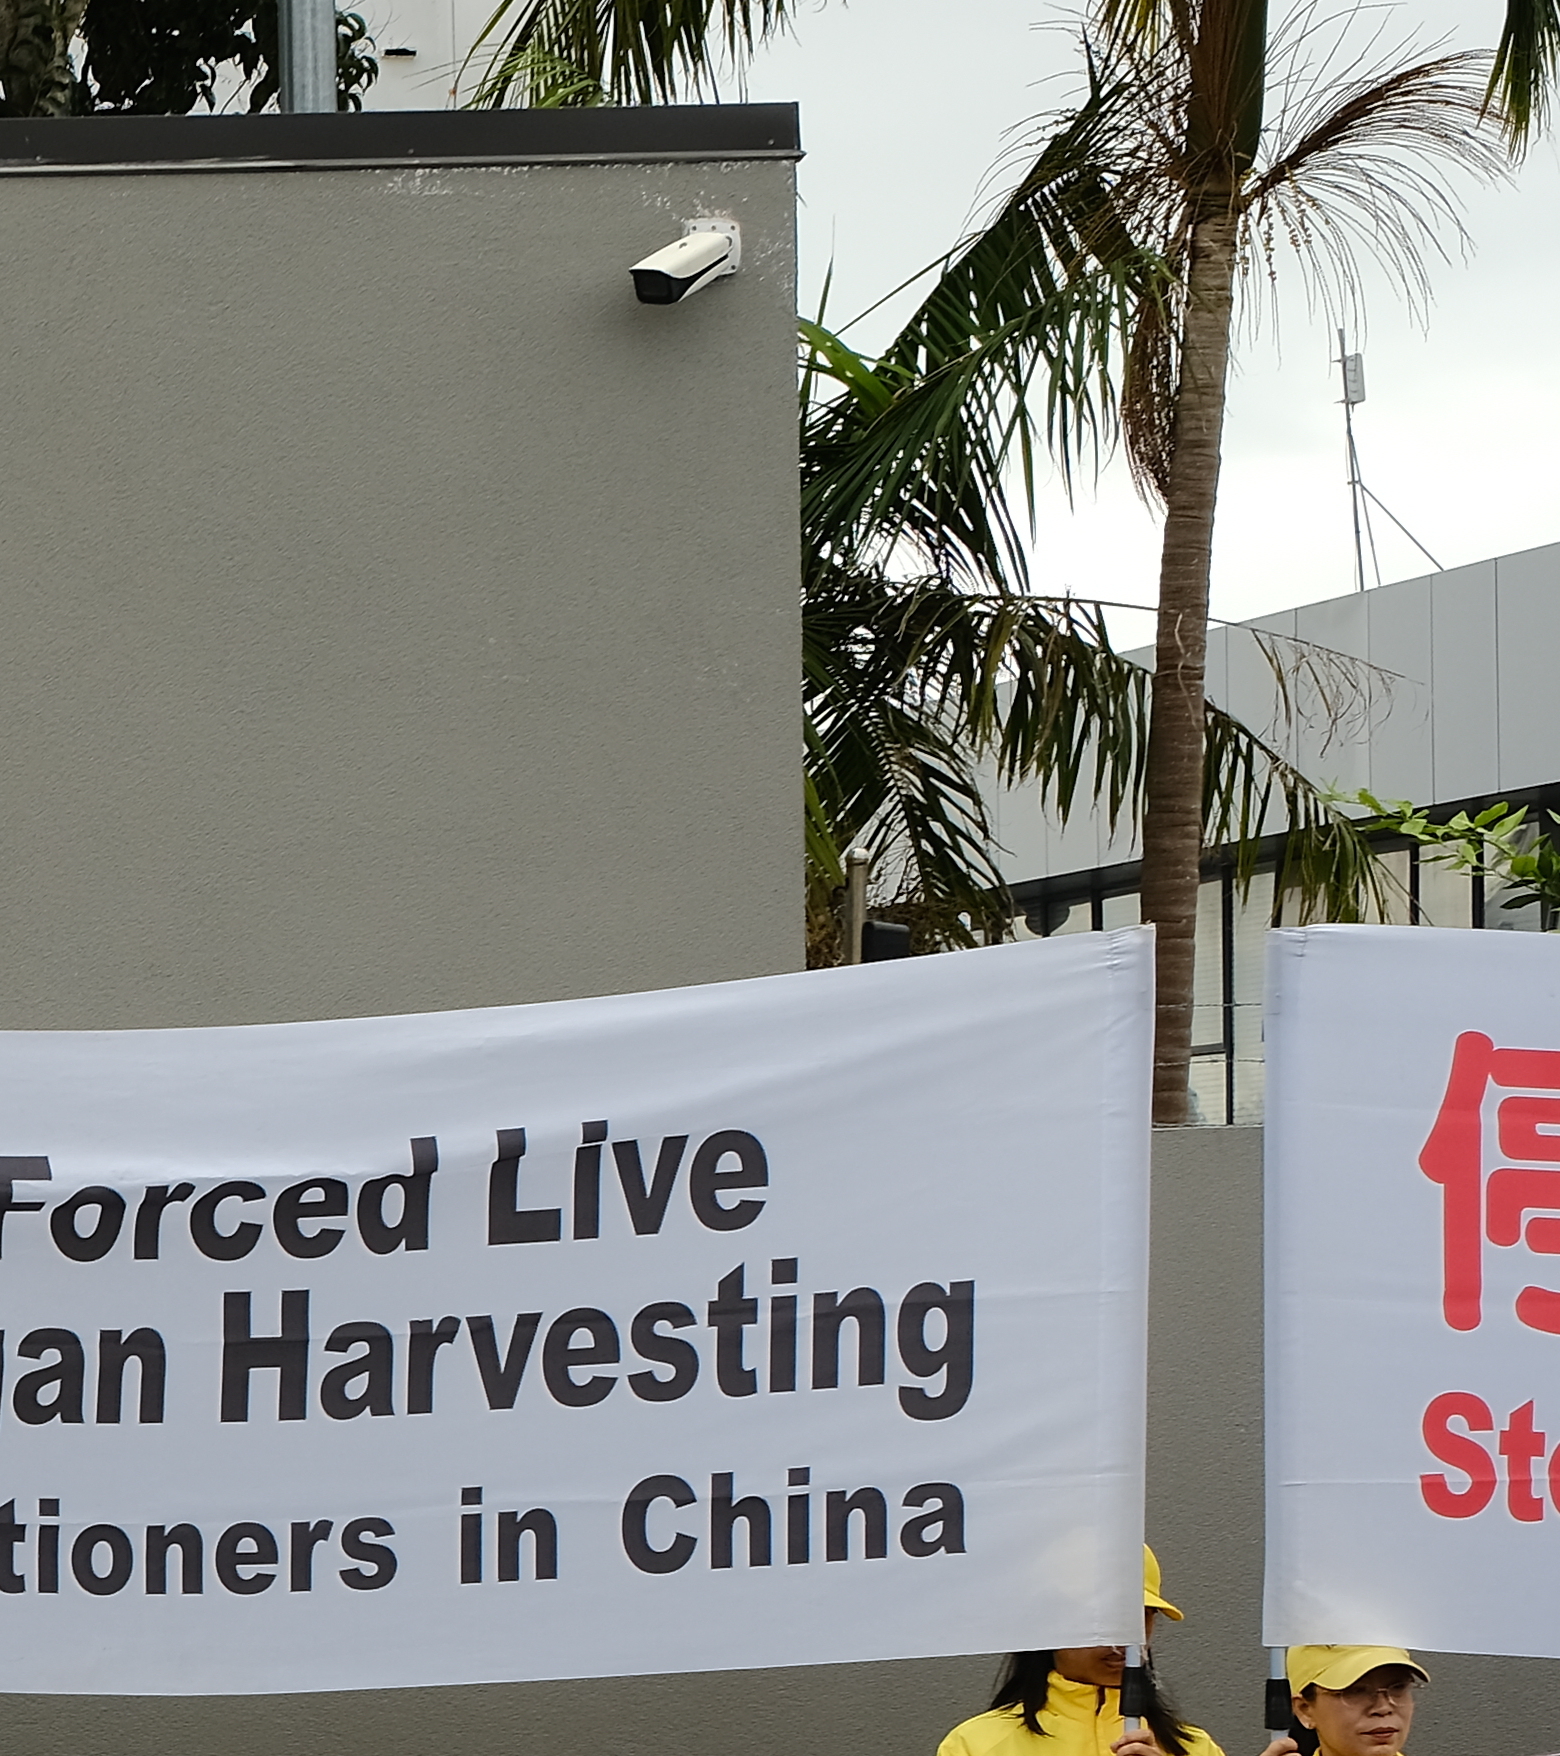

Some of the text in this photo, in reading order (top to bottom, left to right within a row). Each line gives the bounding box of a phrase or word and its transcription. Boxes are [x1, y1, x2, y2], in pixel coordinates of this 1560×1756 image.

[488, 1120, 768, 1245] Live
[220, 1257, 976, 1422] Harvesting
[1419, 1391, 1560, 1522] St
[461, 1487, 557, 1584] in
[622, 1467, 966, 1574] China
